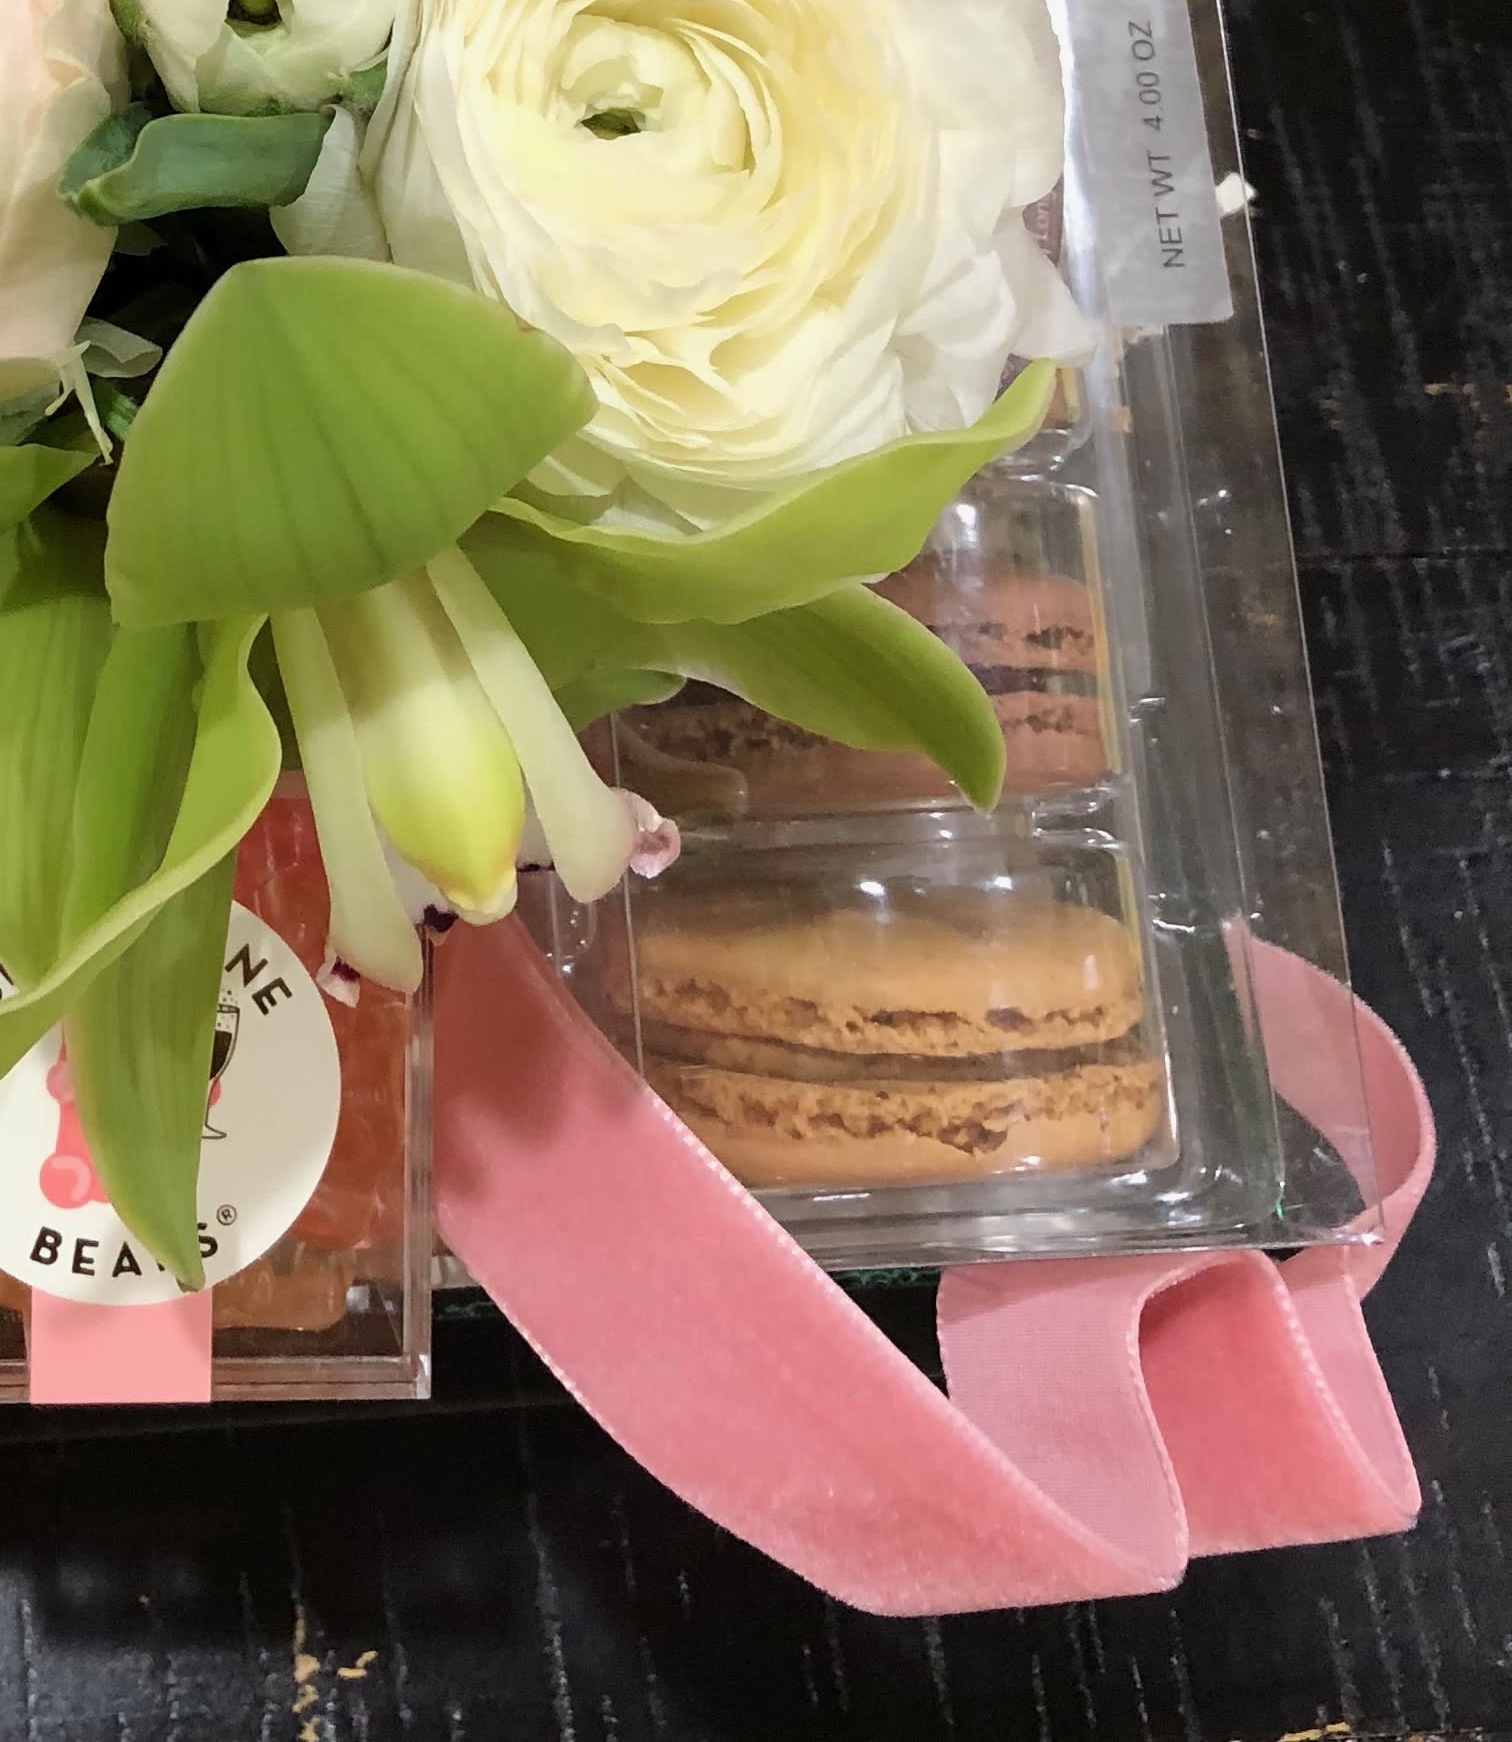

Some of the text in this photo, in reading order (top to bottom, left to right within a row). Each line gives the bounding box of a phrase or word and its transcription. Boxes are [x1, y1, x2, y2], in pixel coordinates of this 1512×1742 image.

[1128, 20, 1156, 61] OZ
[1136, 71, 1164, 131] 4.00
[1146, 149, 1176, 198] WT
[1155, 206, 1186, 269] NET
[29, 1221, 220, 1280] BEAS
